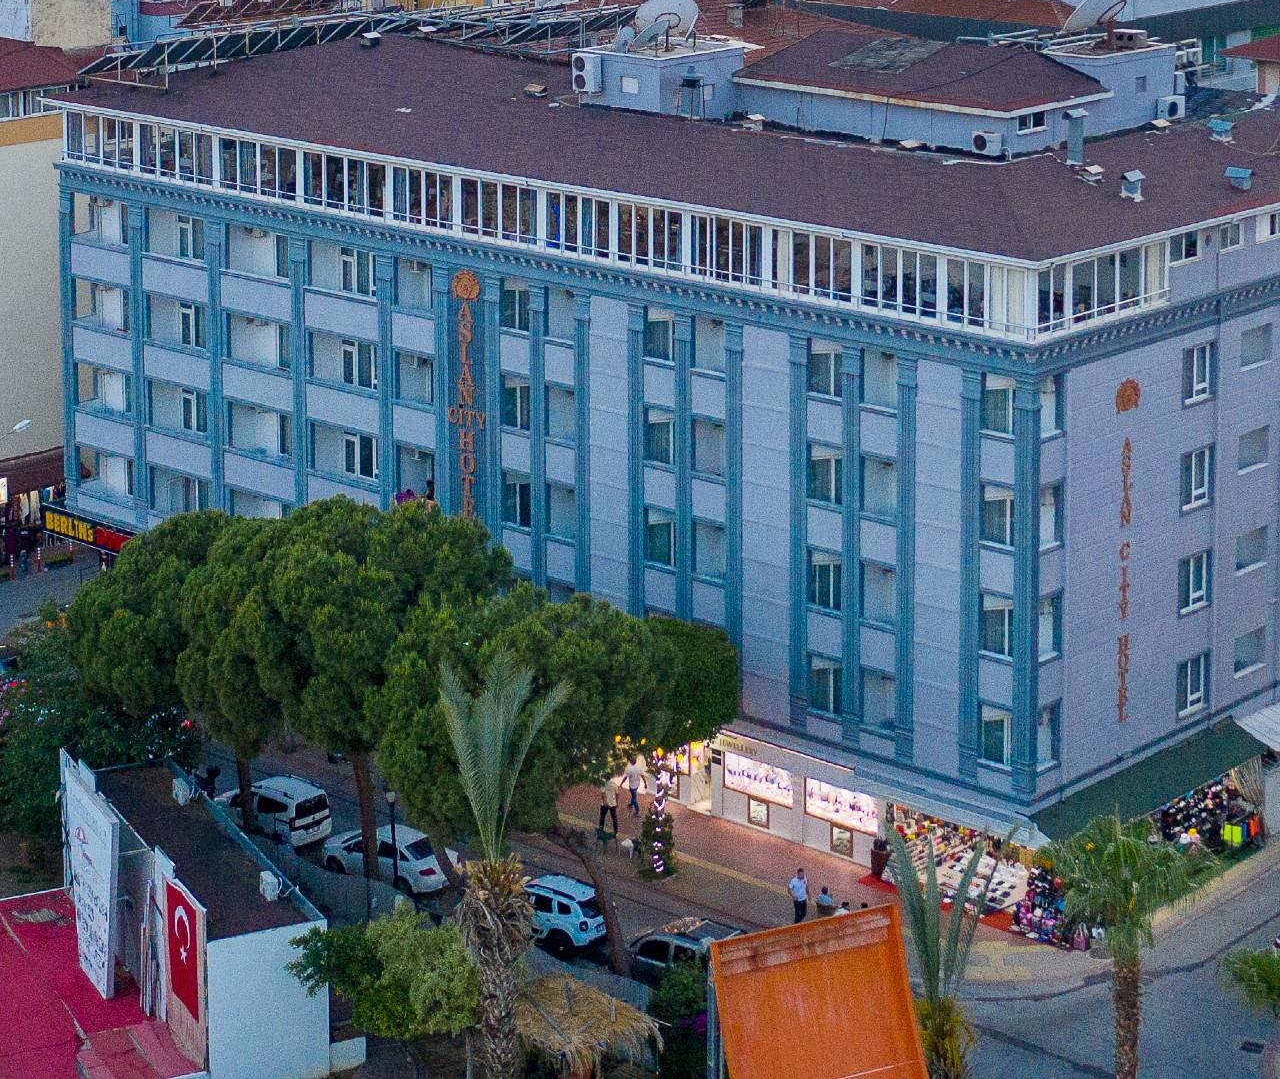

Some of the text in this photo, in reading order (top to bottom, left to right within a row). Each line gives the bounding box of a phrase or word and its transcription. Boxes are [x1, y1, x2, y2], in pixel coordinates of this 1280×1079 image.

[458, 301, 475, 407] ASIAN
[448, 407, 487, 430] CITY
[1117, 632, 1130, 724] HOTEL
